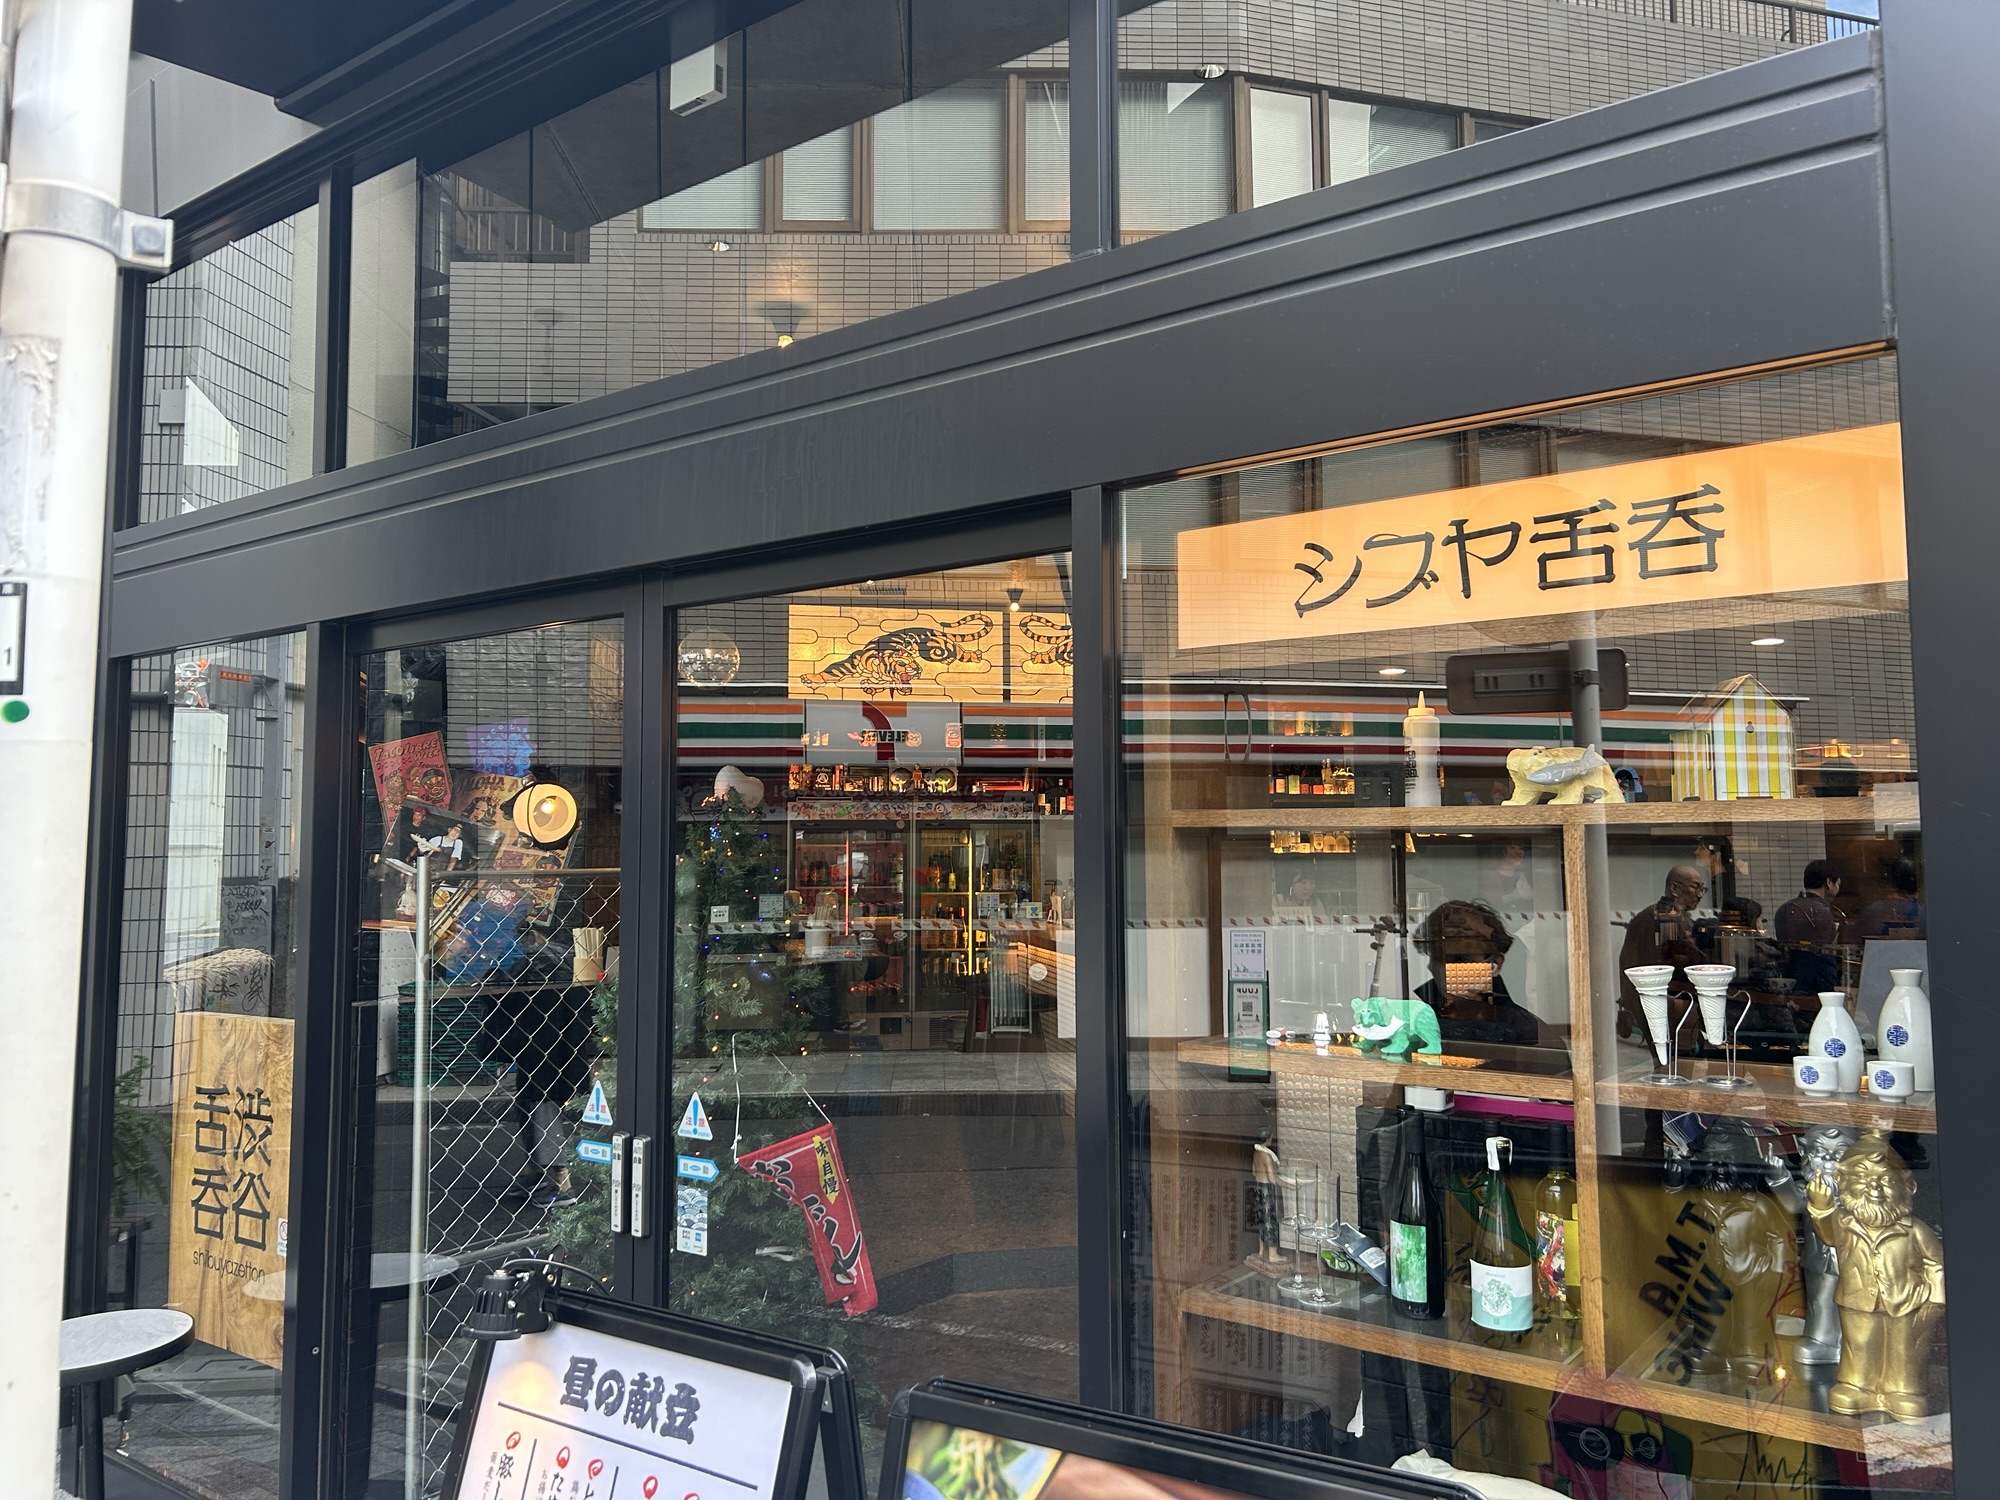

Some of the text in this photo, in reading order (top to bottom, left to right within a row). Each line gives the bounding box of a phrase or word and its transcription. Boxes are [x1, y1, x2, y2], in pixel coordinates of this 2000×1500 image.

[1294, 483, 1725, 620] シブヤ舌呑
[190, 1083, 231, 1241] 舌呑
[231, 1085, 275, 1252] 渋谷
[815, 1141, 841, 1196] 味自慢
[193, 1248, 266, 1285] shibuyazetton
[559, 1354, 701, 1446] 昼の献立
